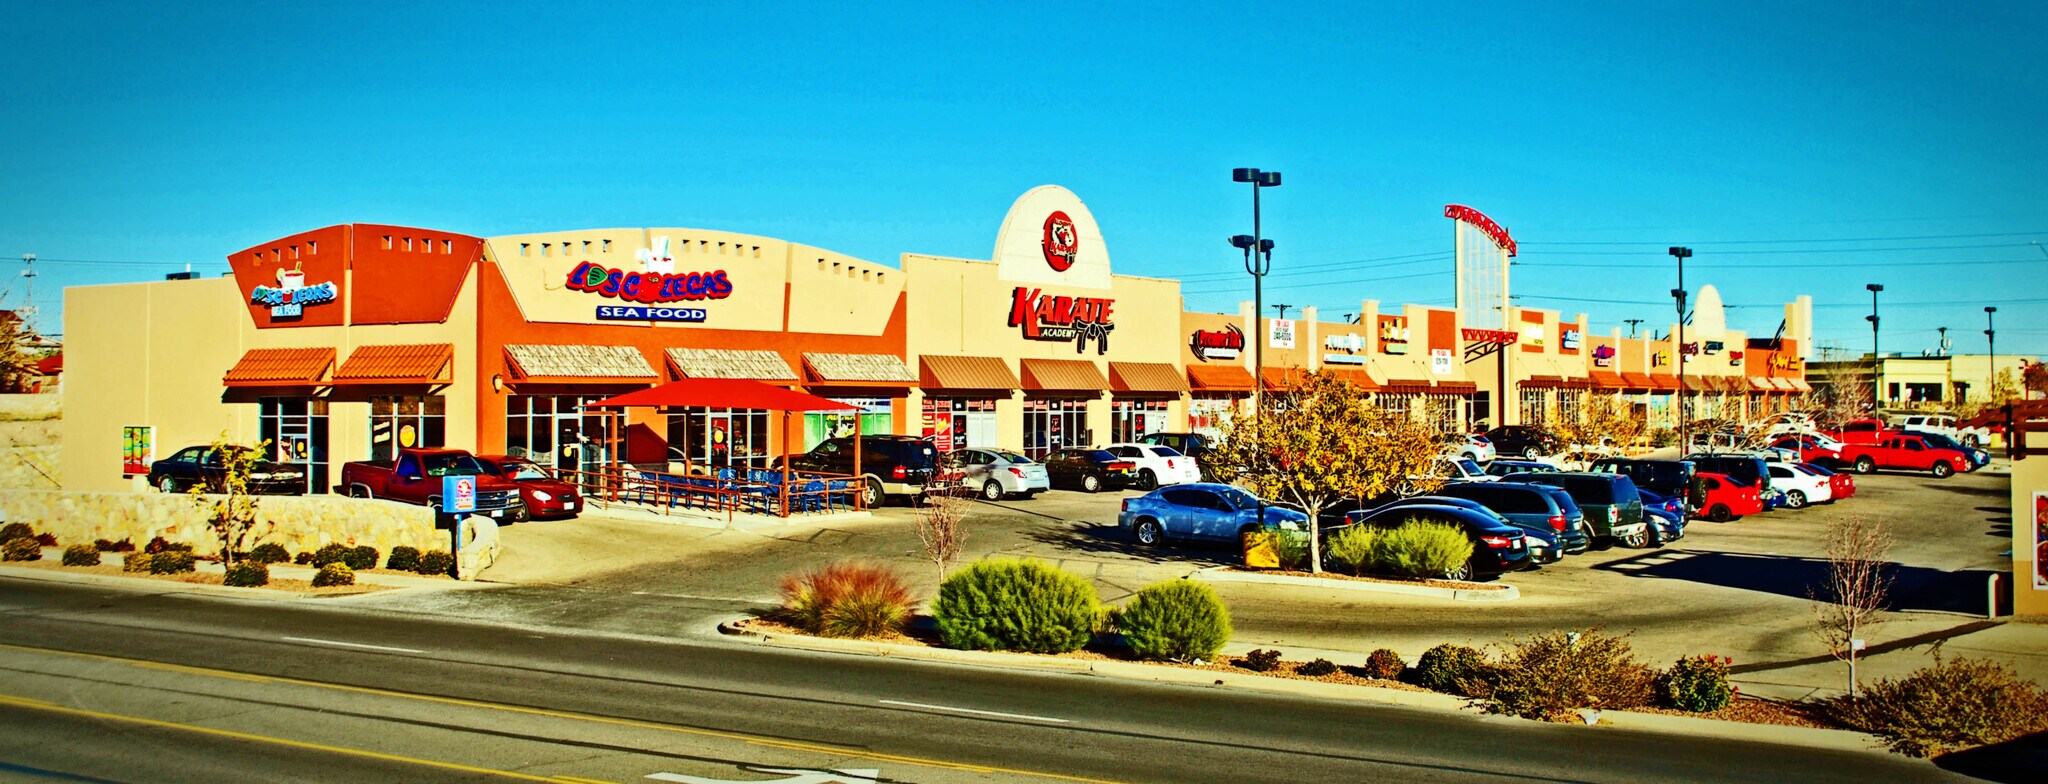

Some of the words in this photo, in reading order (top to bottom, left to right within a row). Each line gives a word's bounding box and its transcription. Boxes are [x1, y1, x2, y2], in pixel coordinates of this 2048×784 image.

[600, 306, 639, 318] SEA
[646, 307, 705, 320] FOOD
[1010, 286, 1116, 338] KARATE
[1041, 328, 1077, 338] ACADEMY
